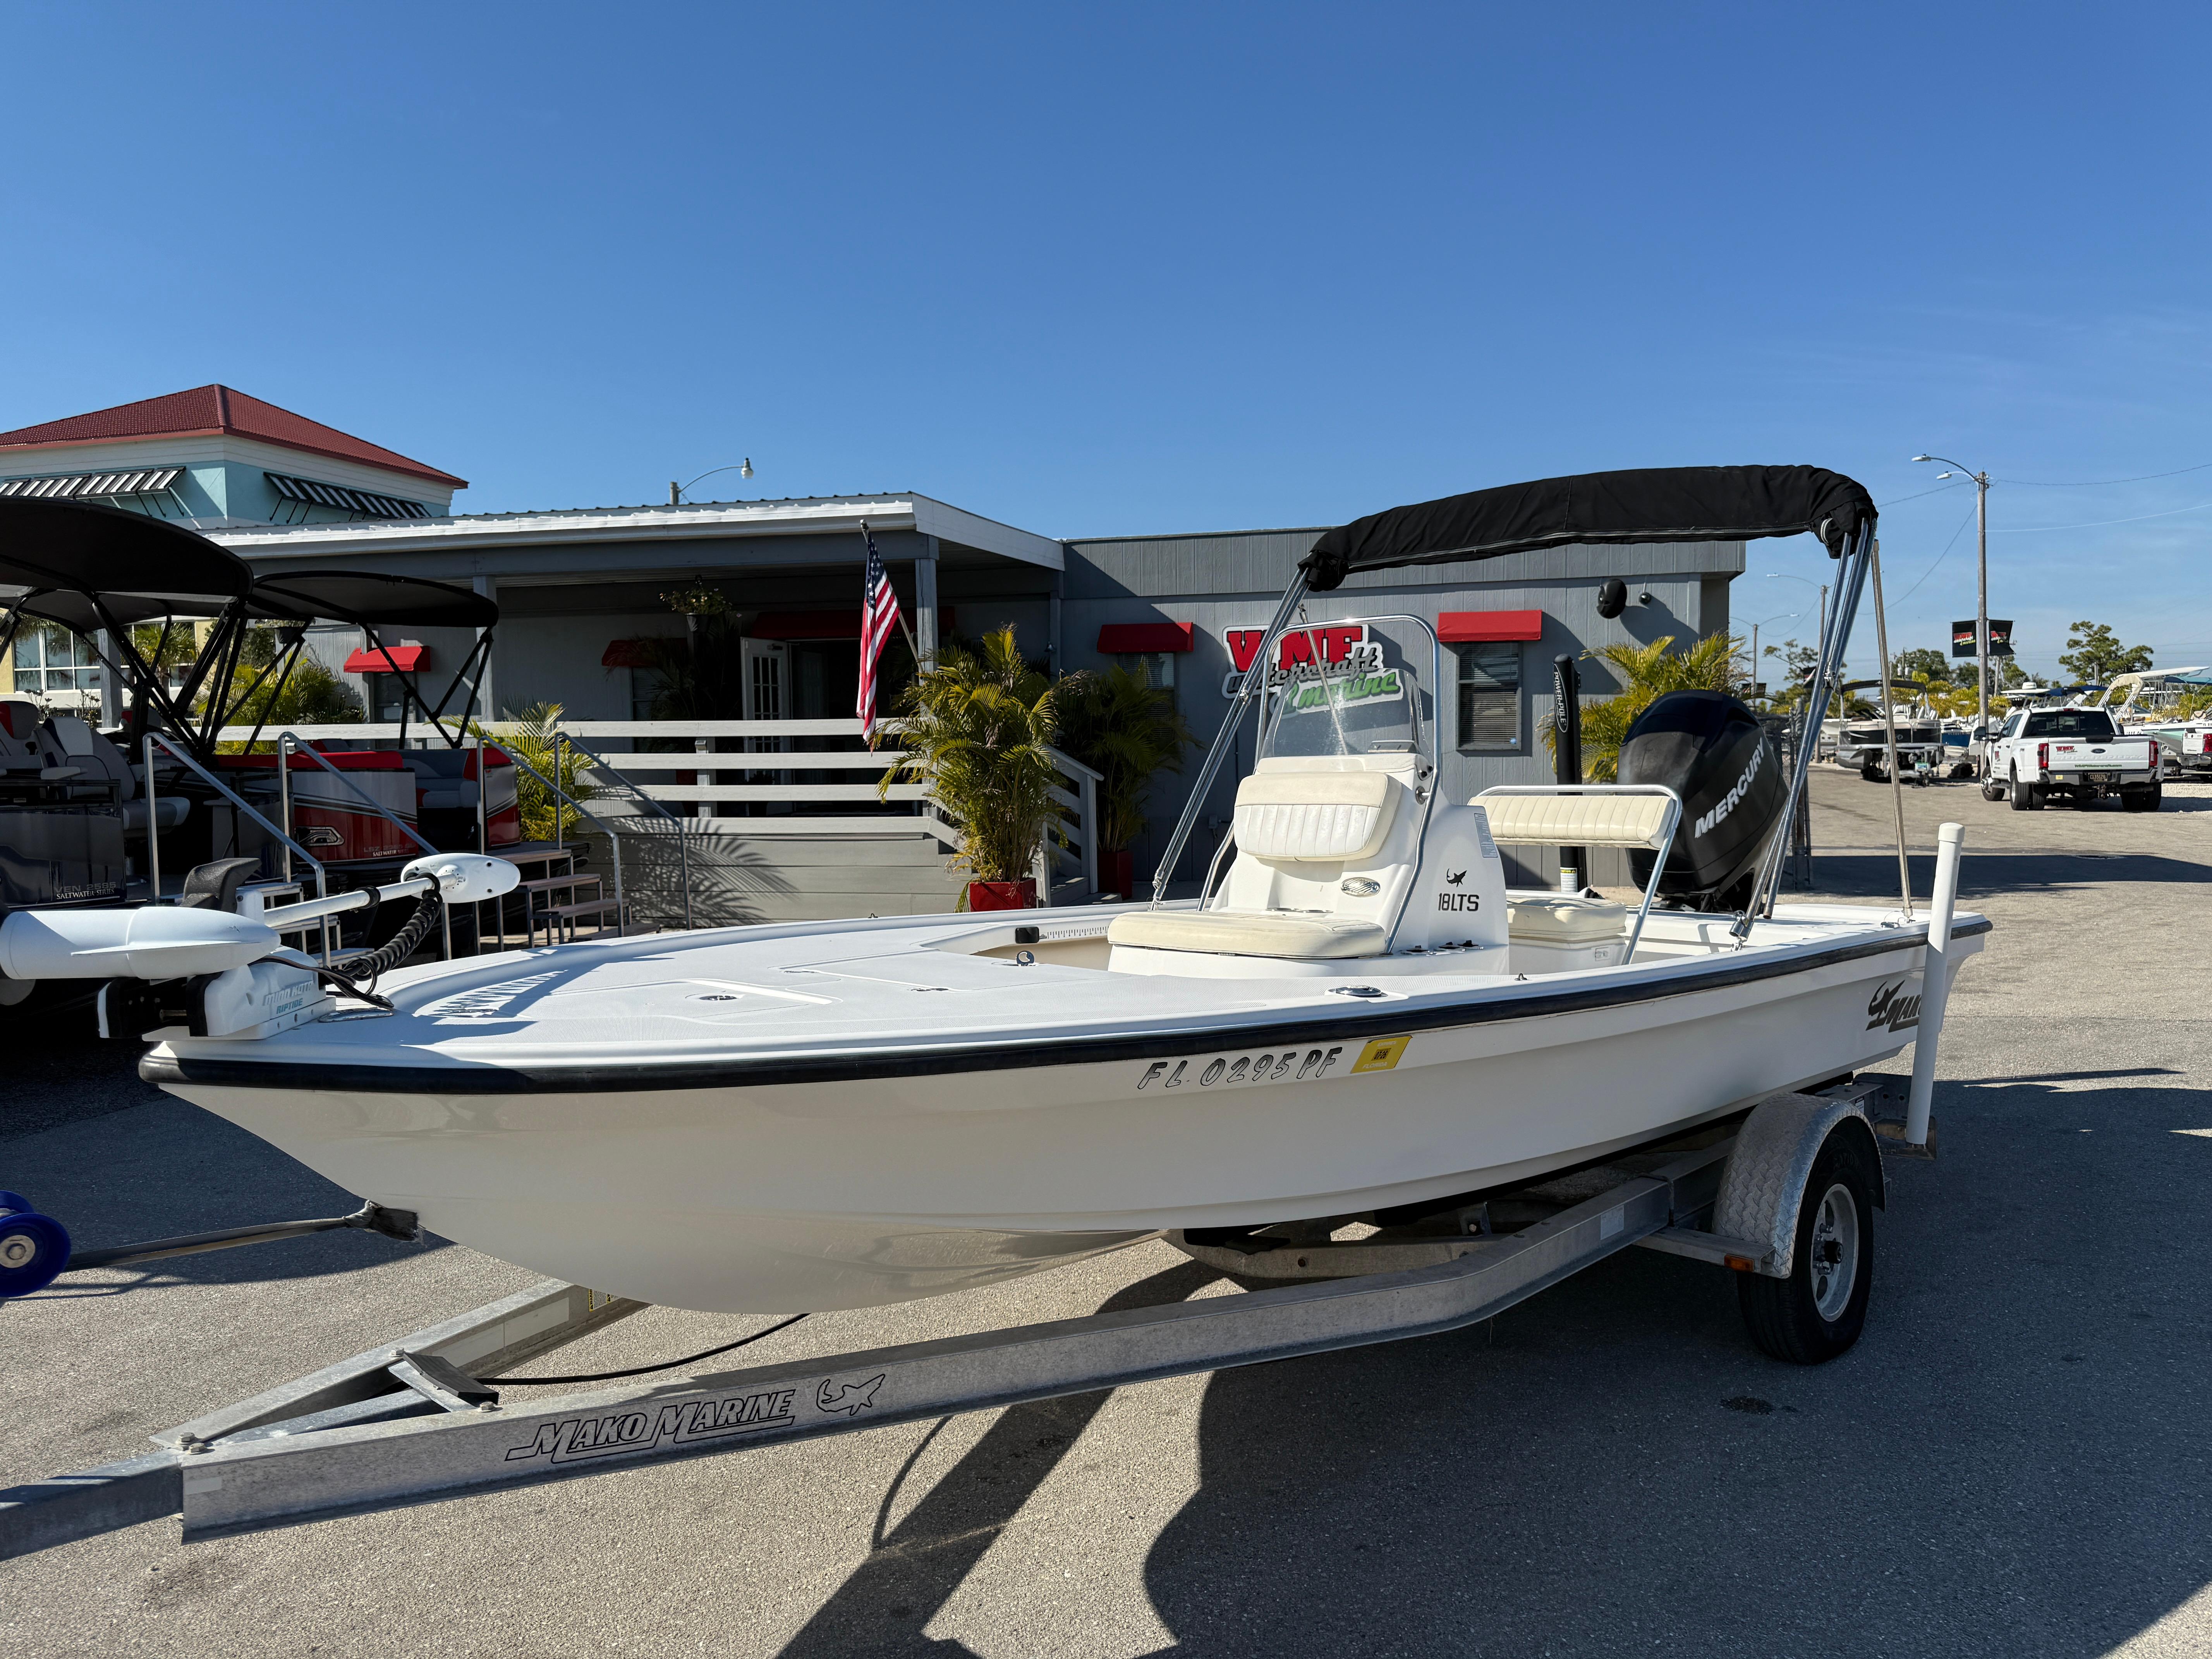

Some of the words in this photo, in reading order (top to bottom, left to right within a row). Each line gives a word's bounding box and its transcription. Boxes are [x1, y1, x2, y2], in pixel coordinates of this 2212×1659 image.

[1554, 672, 1566, 723] POWER-POLE
[1695, 737, 1764, 838] MERCURY
[53, 885, 81, 893] VEN
[57, 891, 95, 899] SALTWATER
[1438, 893, 1479, 912] 18LTS
[276, 998, 303, 1014] RIPTIDE
[1137, 1060, 1188, 1090] FL
[1200, 1050, 1297, 1086] 0295
[1296, 1047, 1343, 1079] PF
[531, 1412, 648, 1463] MAKO
[655, 1389, 796, 1444] MARINE
